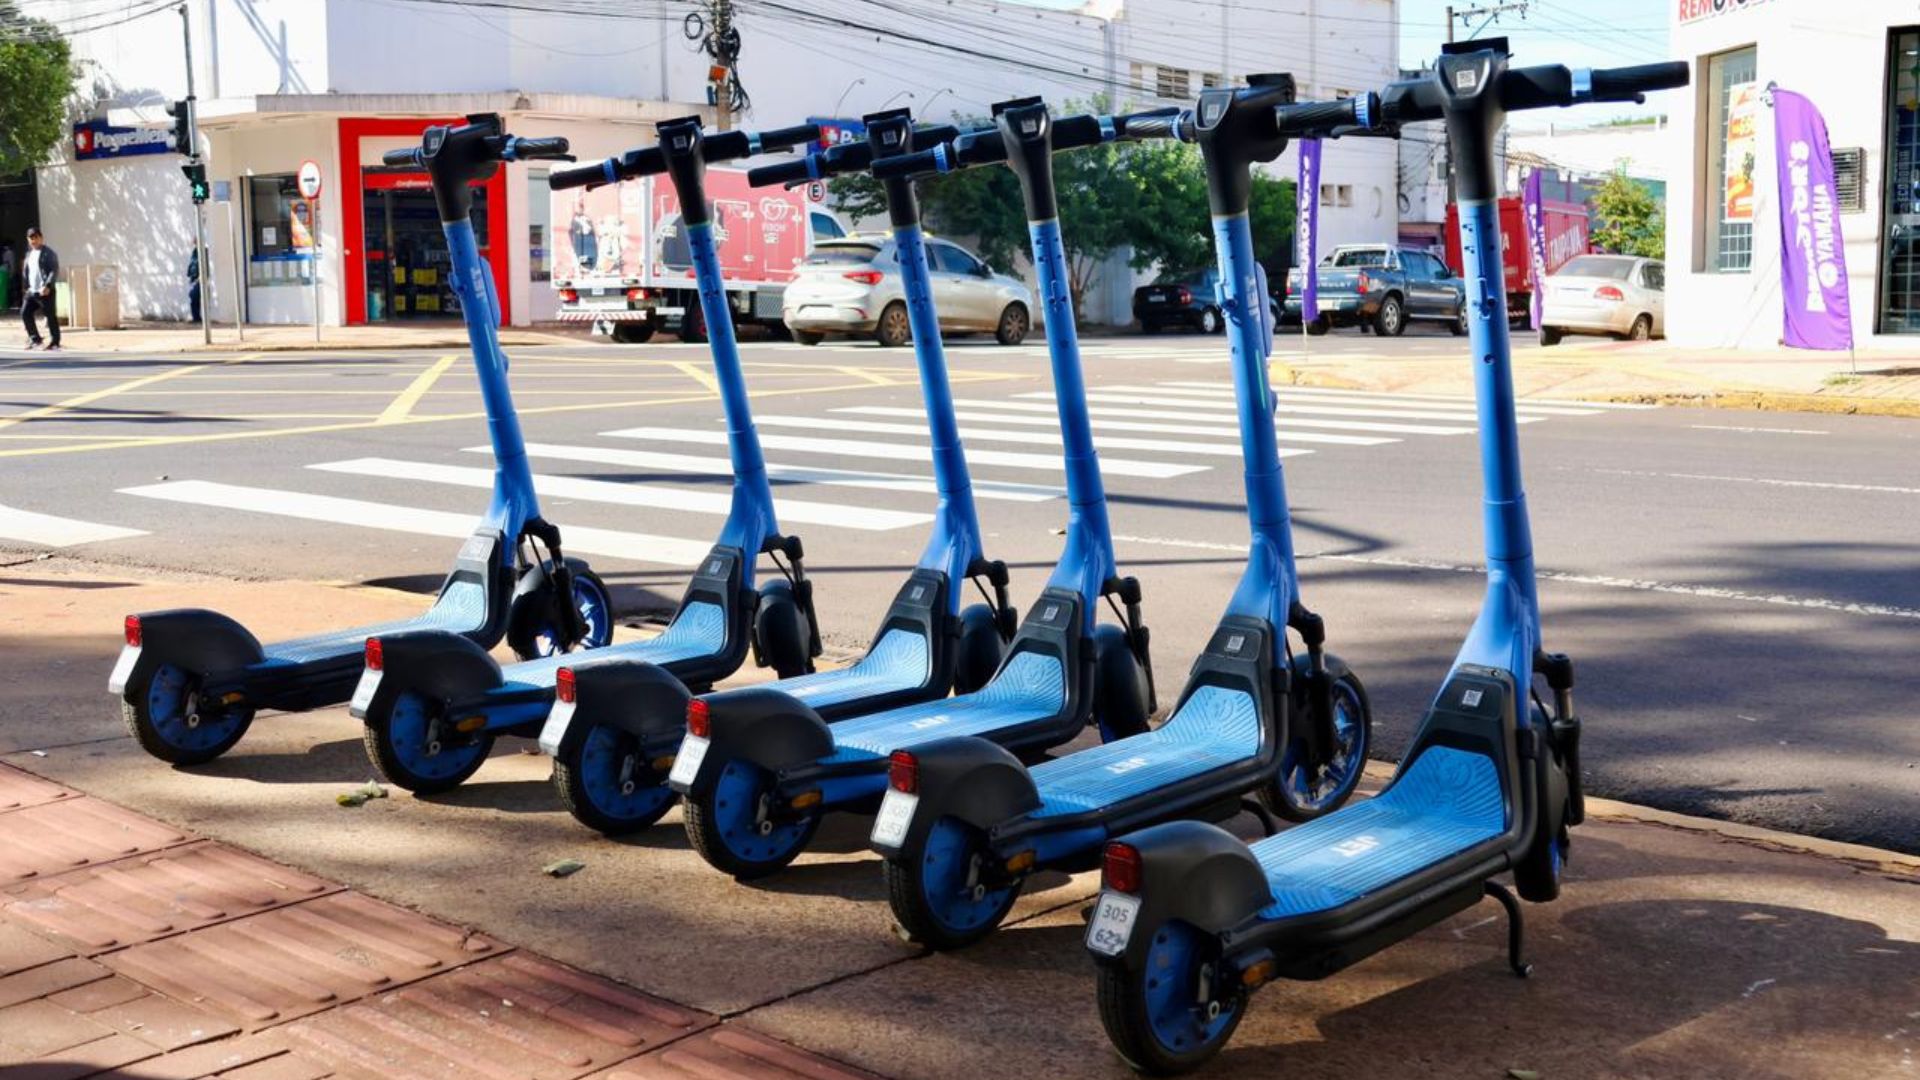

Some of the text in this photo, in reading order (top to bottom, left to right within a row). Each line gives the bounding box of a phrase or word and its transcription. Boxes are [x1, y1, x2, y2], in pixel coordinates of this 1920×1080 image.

[812, 184, 819, 198] E
[1812, 184, 1834, 262] YAMAHA
[1102, 904, 1129, 922] 305
